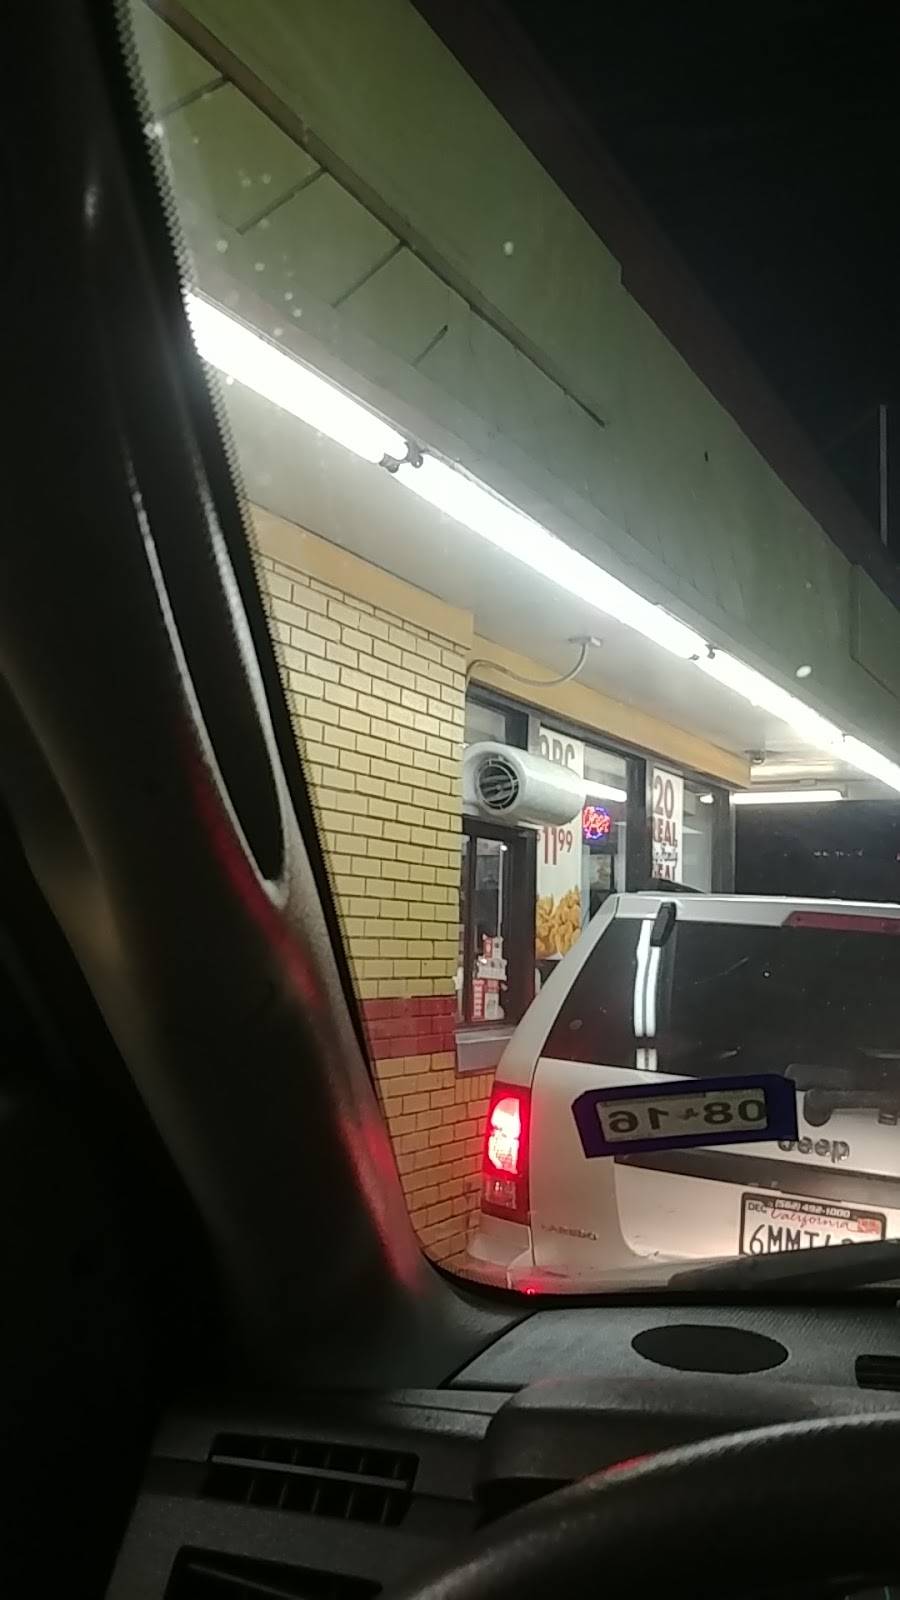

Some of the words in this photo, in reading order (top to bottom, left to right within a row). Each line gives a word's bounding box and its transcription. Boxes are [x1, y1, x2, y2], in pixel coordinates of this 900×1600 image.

[654, 775, 674, 819] 20
[747, 1202, 767, 1214] DEC
[749, 1224, 854, 1255] 6MMT
